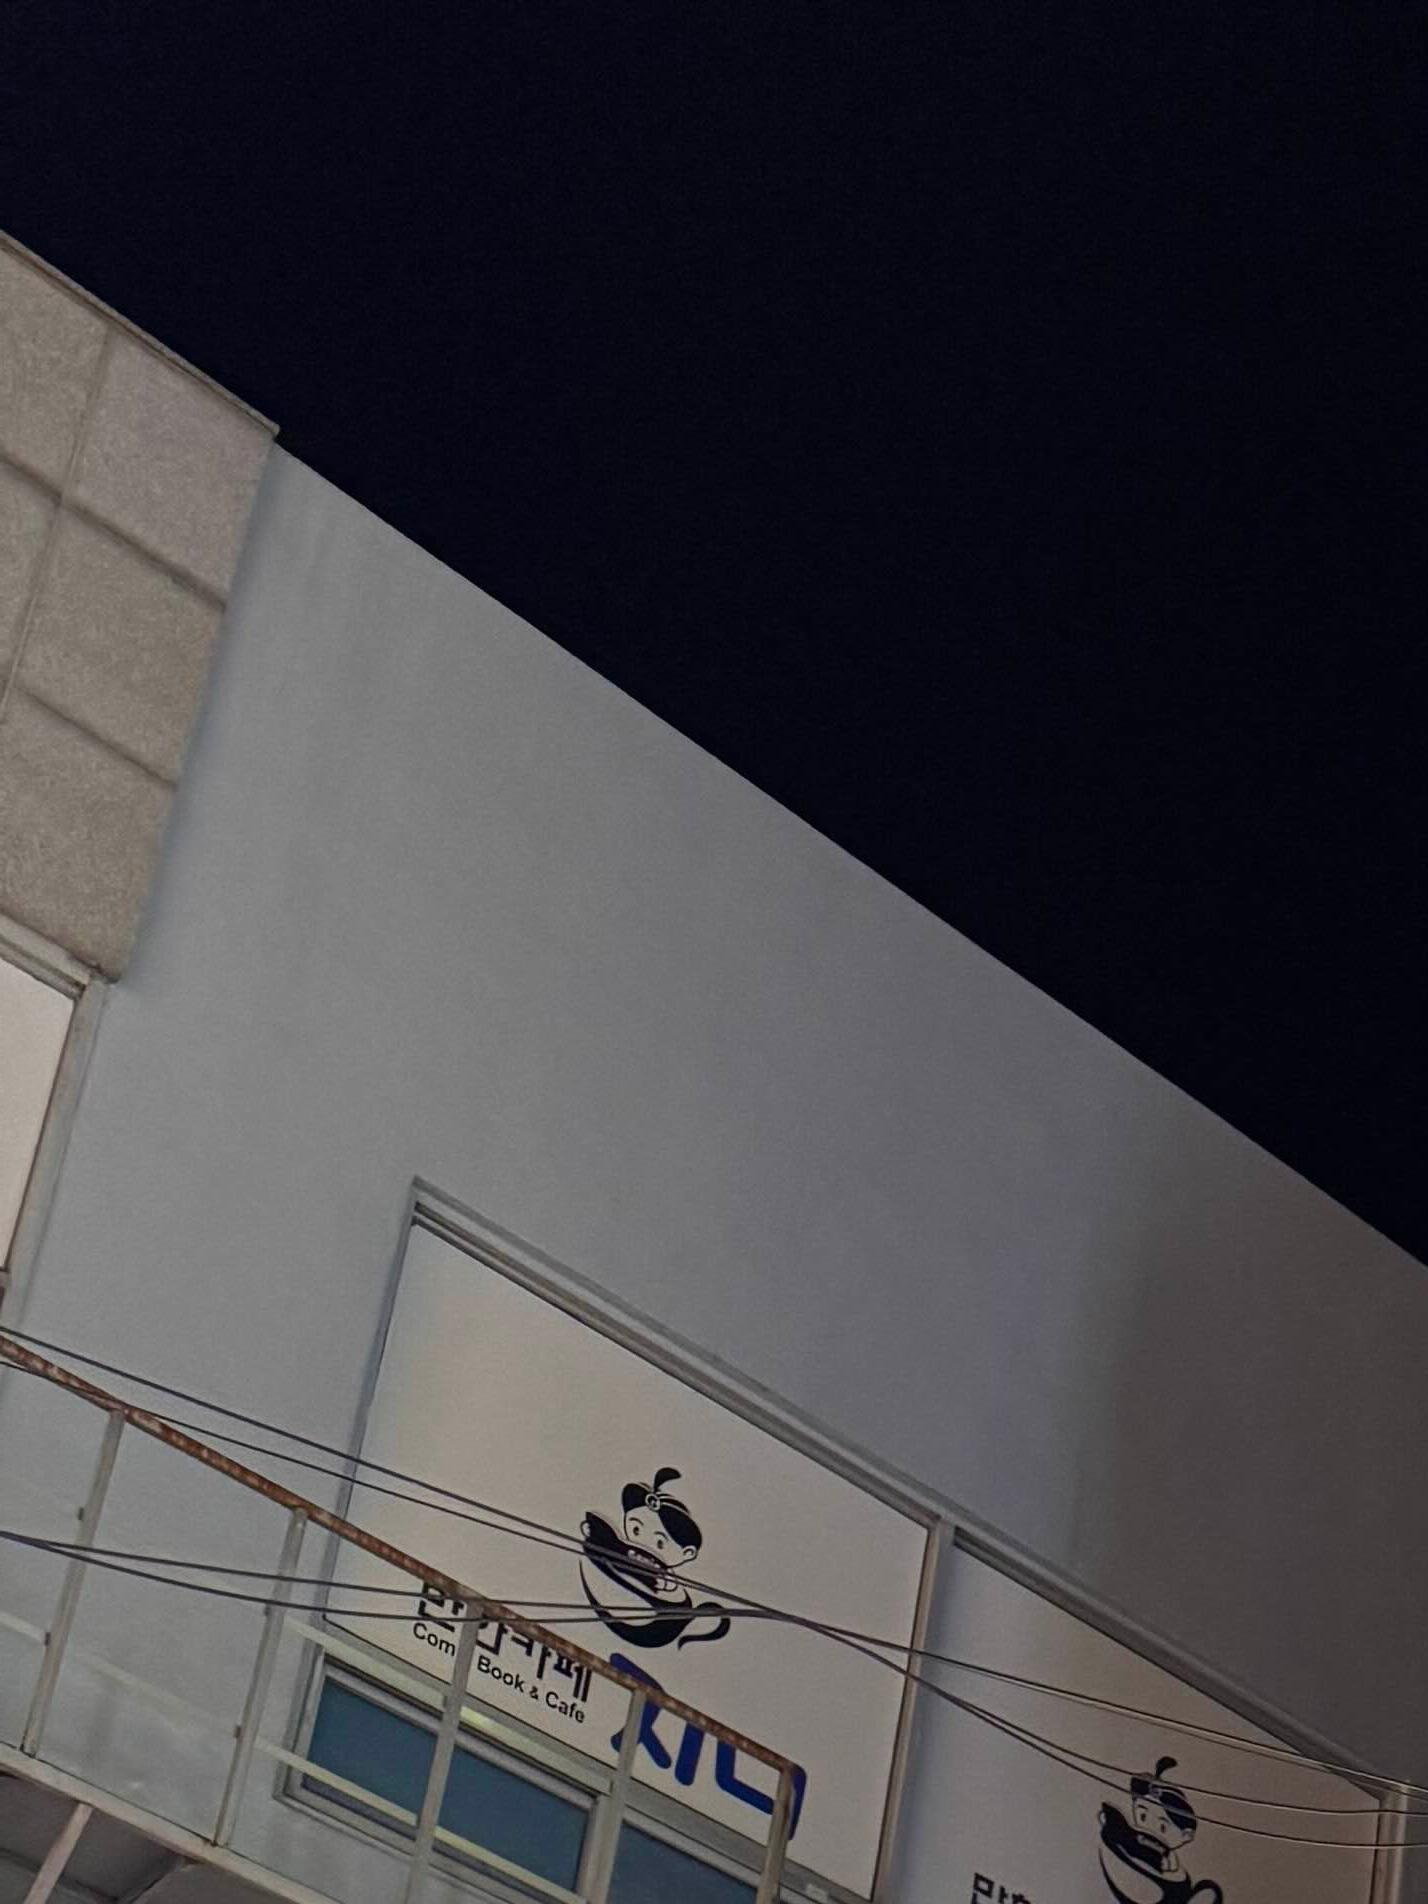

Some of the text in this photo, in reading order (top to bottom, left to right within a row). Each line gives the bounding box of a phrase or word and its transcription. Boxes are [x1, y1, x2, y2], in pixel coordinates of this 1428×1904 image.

[413, 1622, 586, 1724] Com Book & Cafe
[418, 1580, 593, 1703] 만카페
